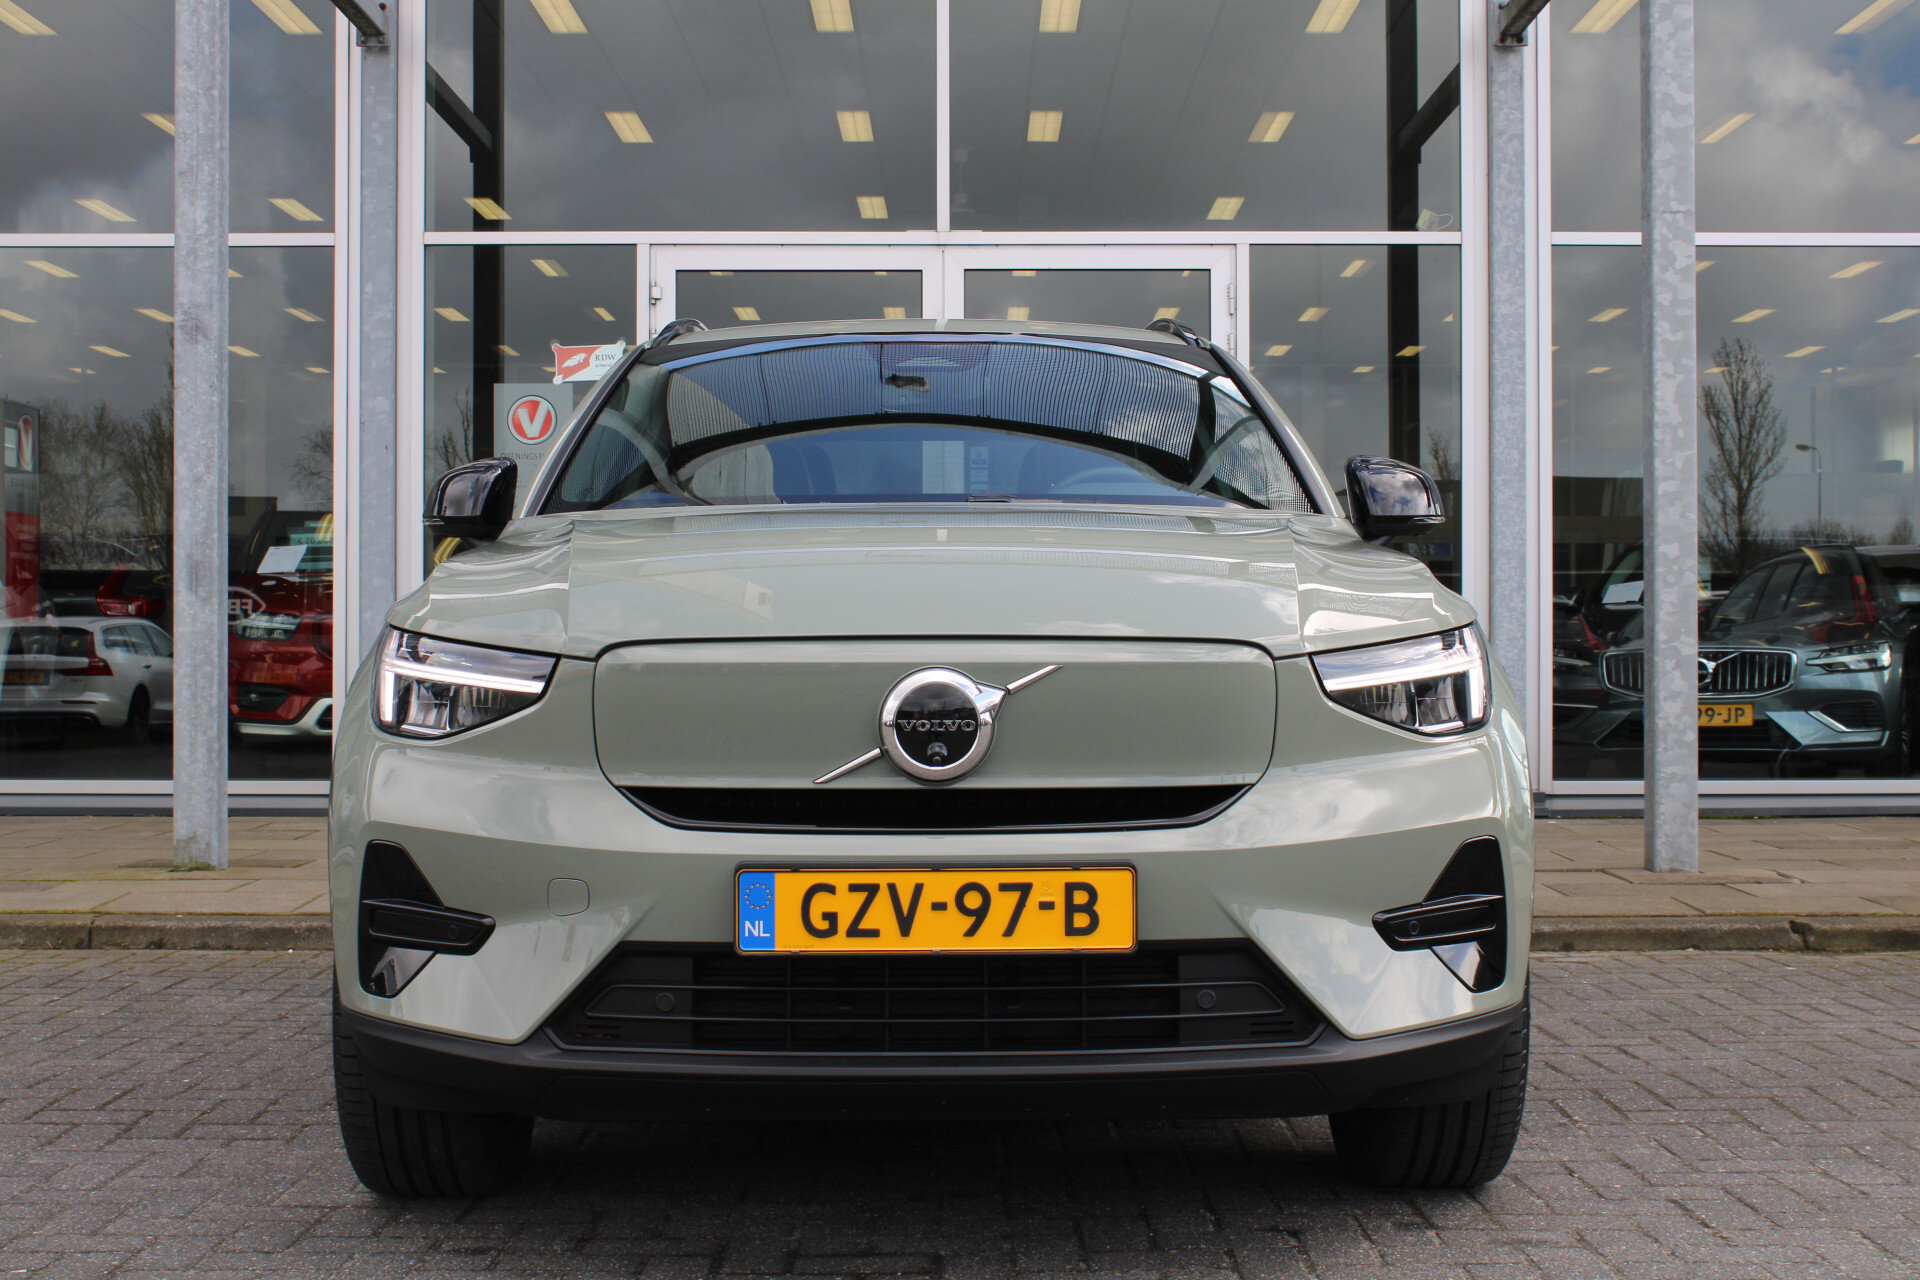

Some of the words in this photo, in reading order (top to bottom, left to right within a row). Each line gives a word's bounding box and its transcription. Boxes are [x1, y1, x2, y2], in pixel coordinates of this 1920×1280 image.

[500, 452, 545, 460] OPENINGST
[898, 719, 976, 732] VOLVO
[801, 882, 1100, 938] GZV-97-B
[744, 920, 771, 937] NL
